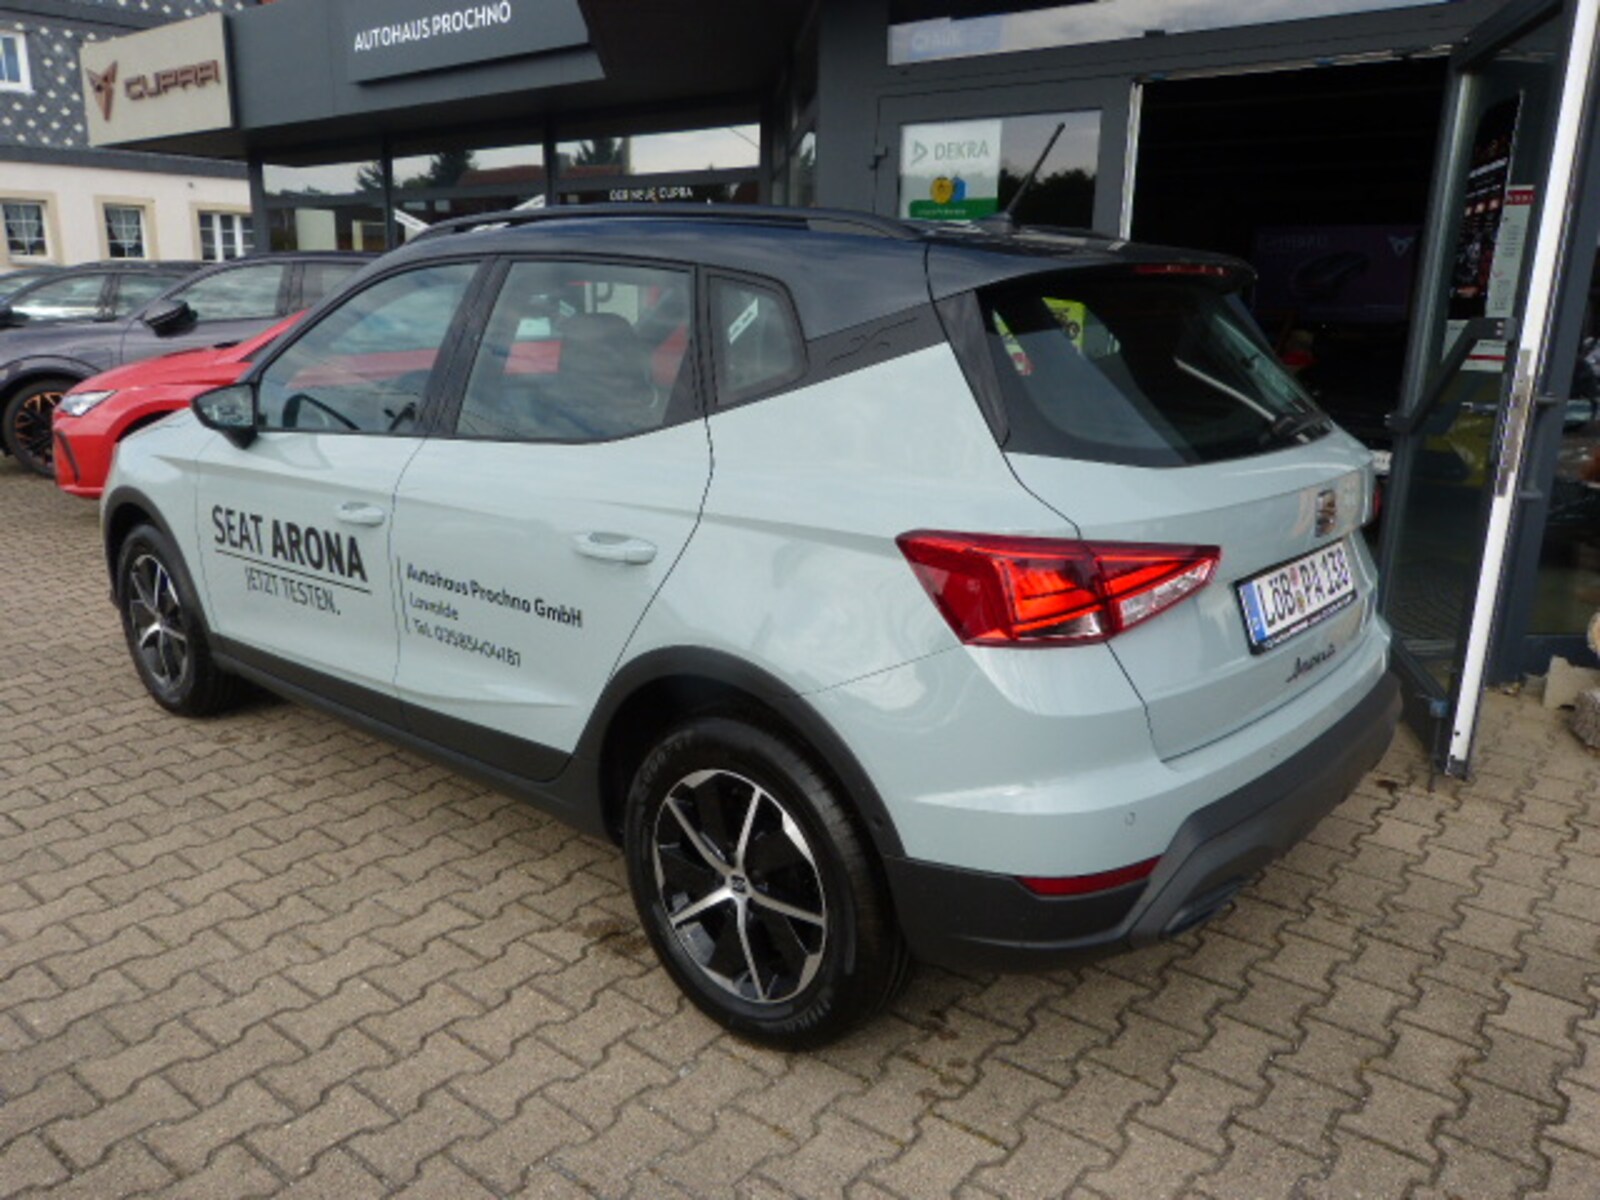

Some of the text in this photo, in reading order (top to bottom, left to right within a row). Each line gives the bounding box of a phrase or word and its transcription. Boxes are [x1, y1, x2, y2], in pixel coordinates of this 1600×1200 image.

[354, 1, 512, 52] AUTOHAUS PROCHNO
[124, 60, 220, 101] CUPRA
[934, 140, 989, 160] DEKRA
[659, 186, 693, 199] CUPRA
[211, 504, 368, 583] SEAT ARONA
[244, 565, 341, 616] JETZT TESTEN.
[407, 563, 584, 628] Autohaus Prochno GmbH
[1256, 572, 1296, 628] LÖB
[1299, 560, 1325, 607] PA
